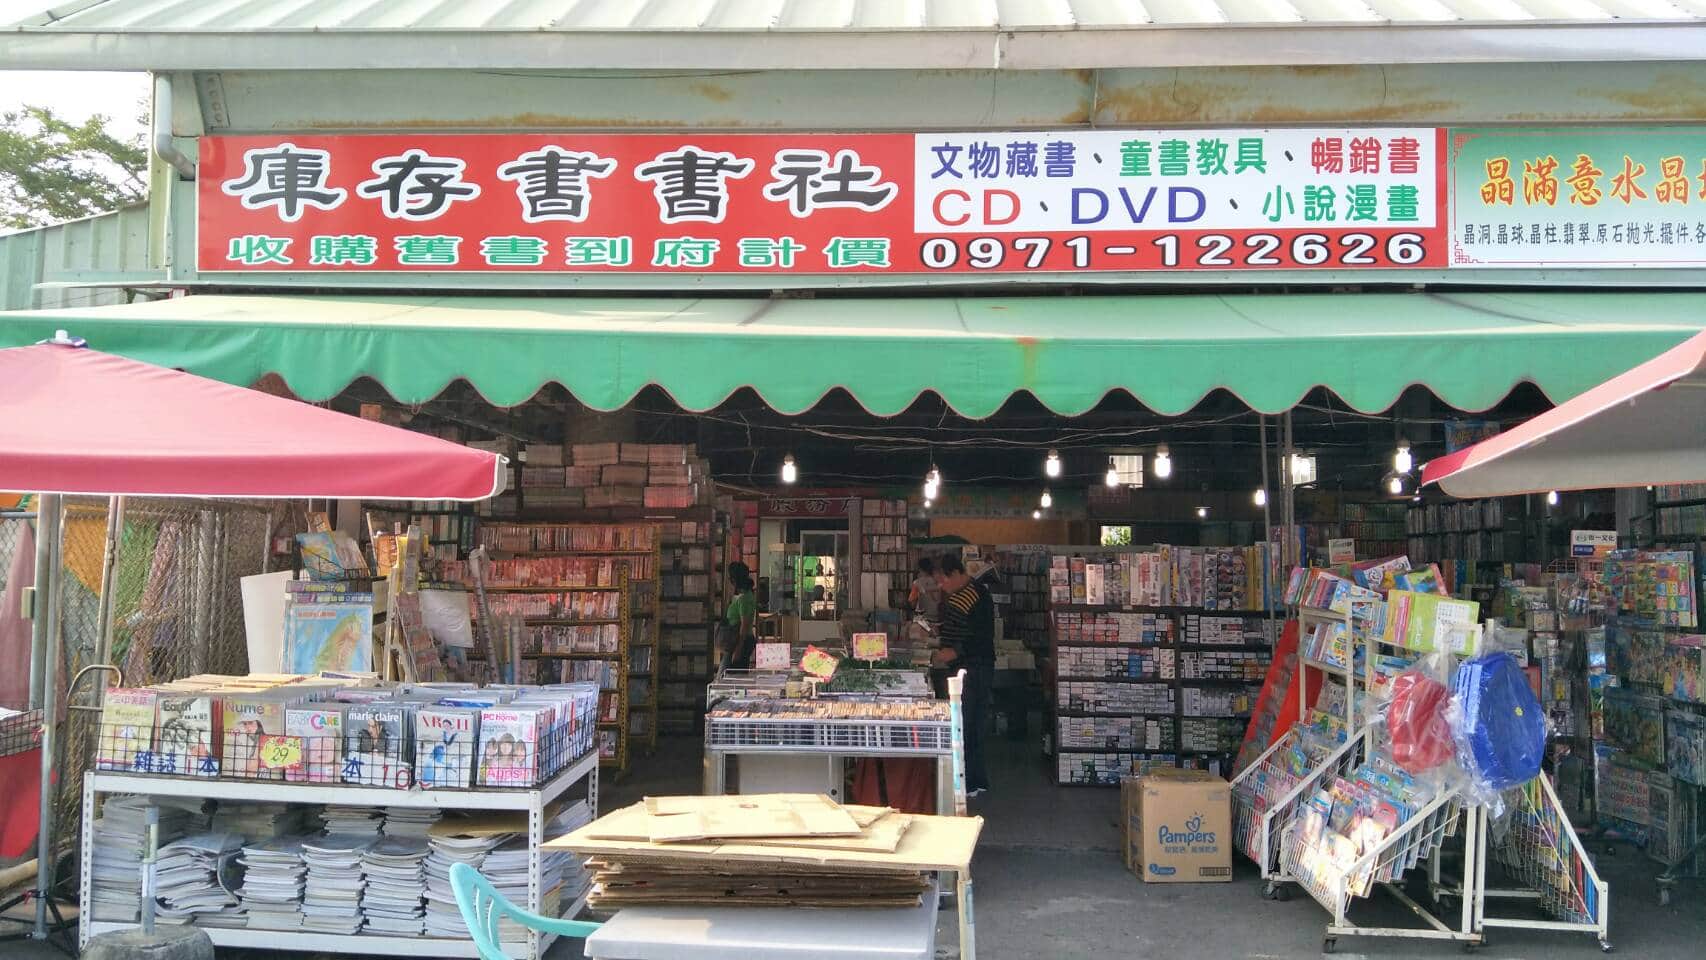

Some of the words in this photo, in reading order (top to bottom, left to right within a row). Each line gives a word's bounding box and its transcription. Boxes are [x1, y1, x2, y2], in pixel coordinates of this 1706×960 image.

[222, 142, 897, 221] 庫存書書社
[229, 236, 890, 267] 收購舊書到府計價
[920, 233, 1426, 267] 0971-122626
[348, 712, 374, 721] marie
[375, 712, 400, 722] claire
[1158, 825, 1217, 846] Pampers
